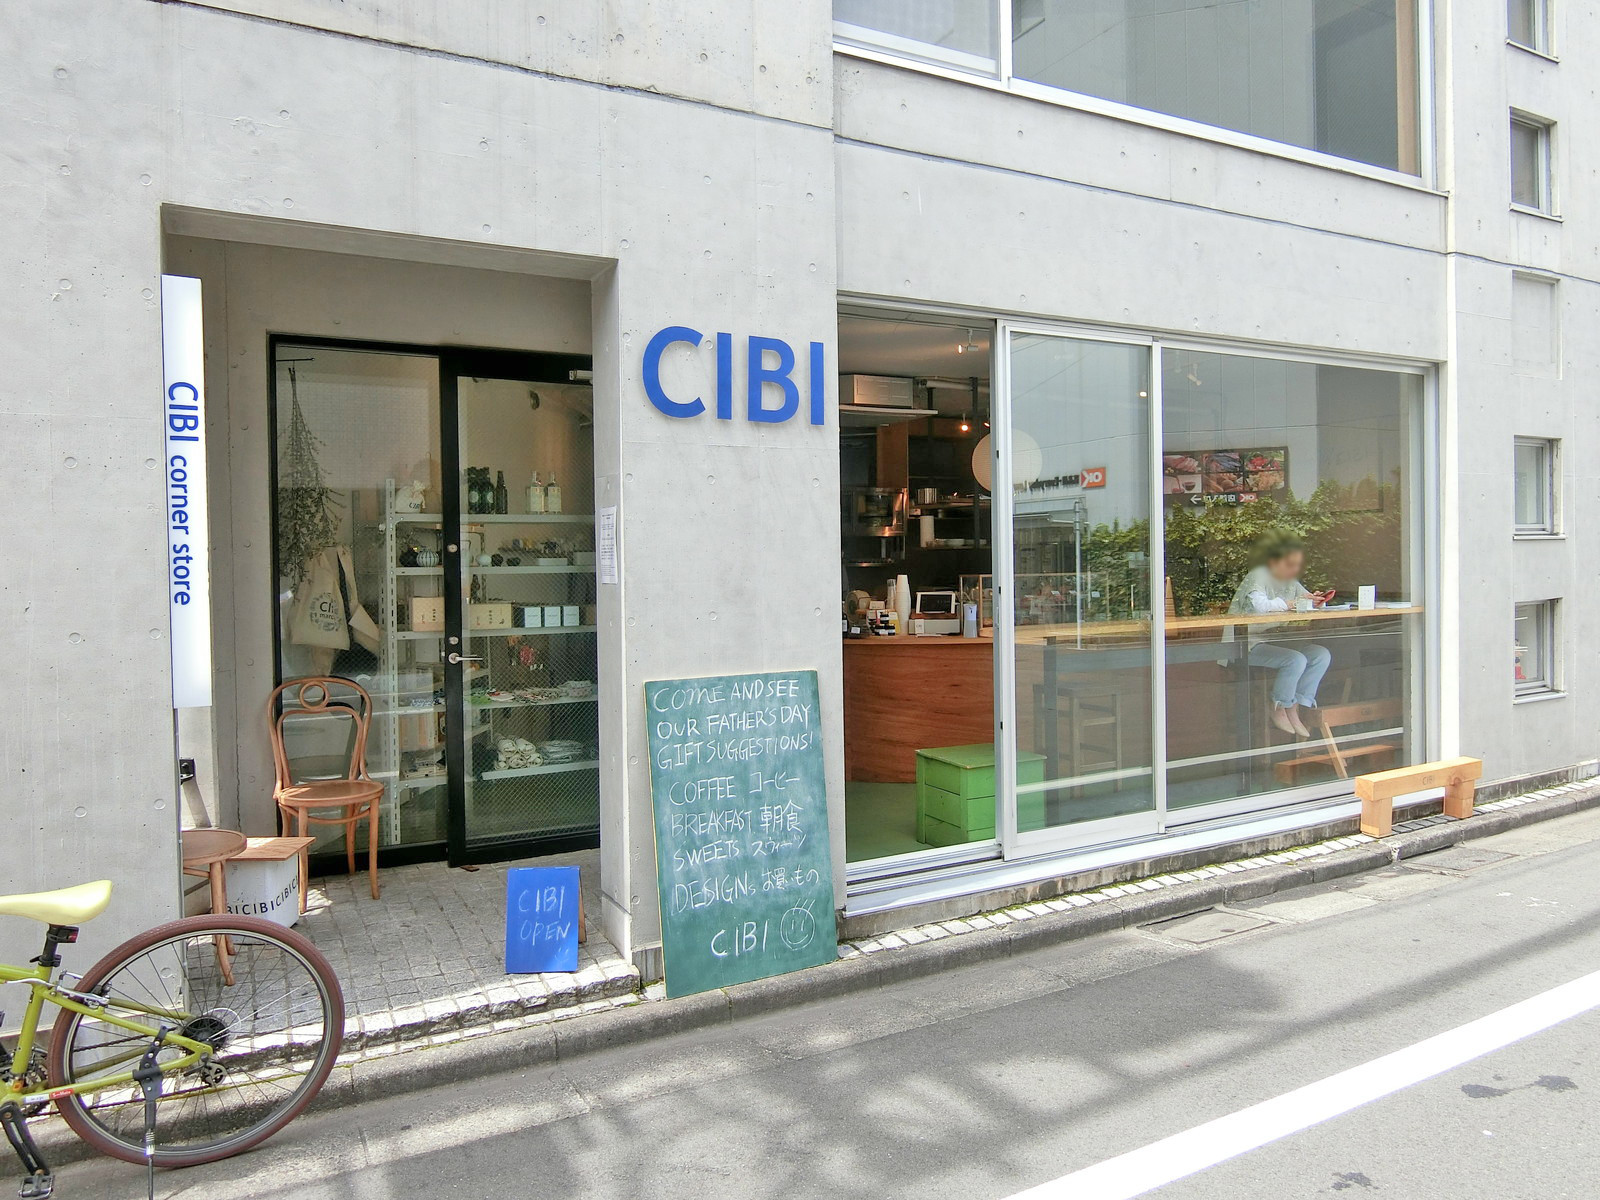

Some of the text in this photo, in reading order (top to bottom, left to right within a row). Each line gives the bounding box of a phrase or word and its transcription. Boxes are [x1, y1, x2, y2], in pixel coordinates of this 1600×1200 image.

[643, 326, 825, 425] CIBI
[168, 382, 199, 605] CIBI corner store
[653, 679, 799, 712] COME AND SEE
[657, 704, 812, 740] OUR FATHER'S DAY
[657, 732, 813, 770] GIFT SUGGESTIONS!
[669, 776, 736, 805] COFFEE
[671, 800, 803, 837] BREAKFAST 朝食
[674, 840, 740, 872] SWEETS
[518, 885, 565, 919] CIBI
[521, 920, 571, 946] OPEN
[711, 920, 769, 957] CIBI
